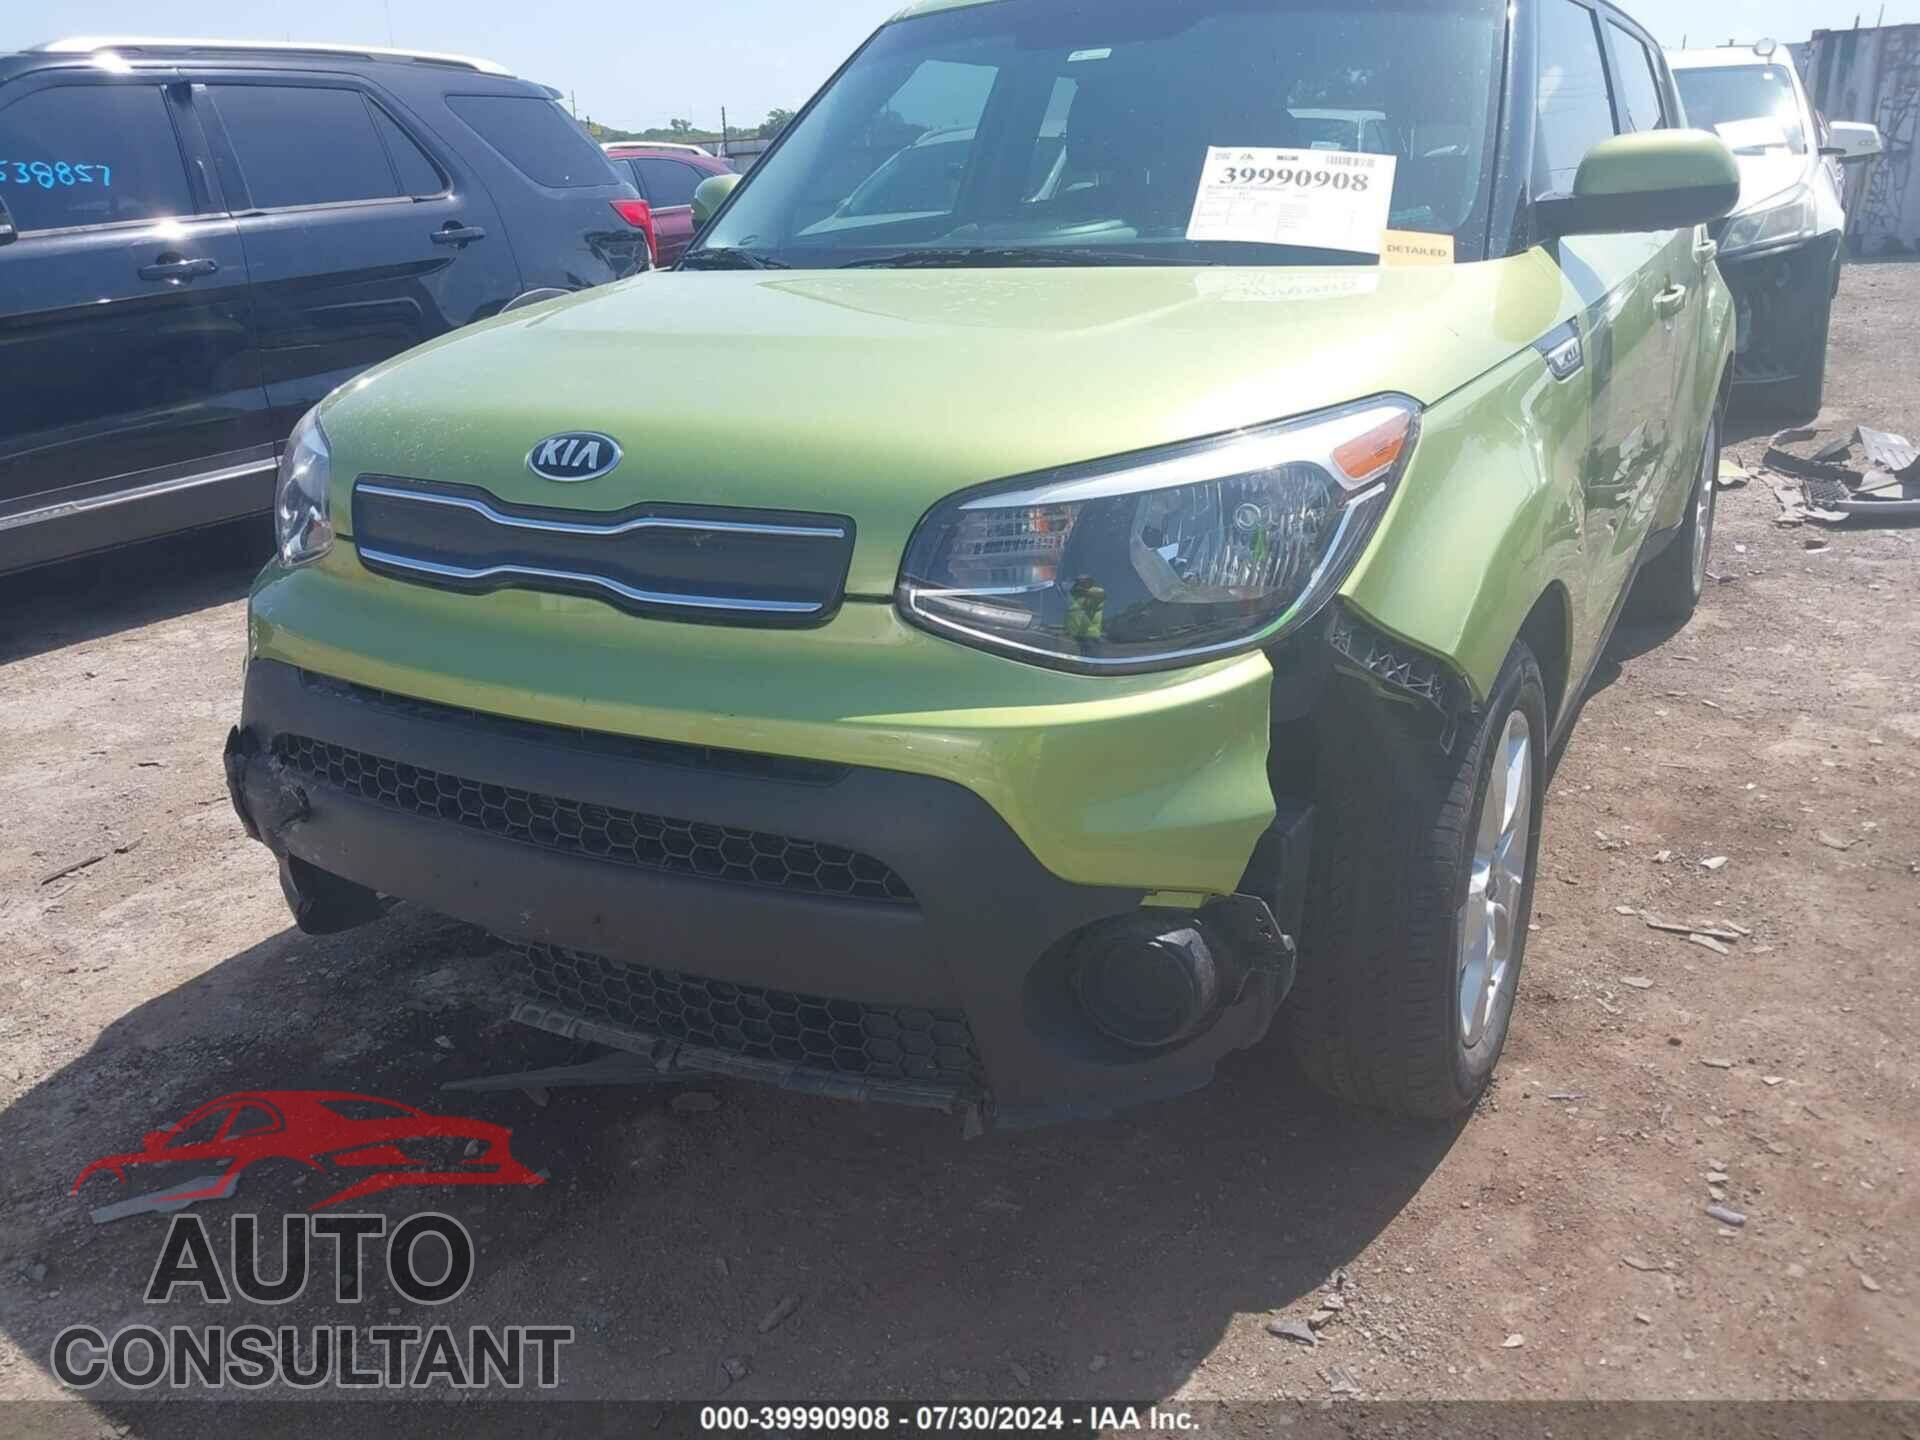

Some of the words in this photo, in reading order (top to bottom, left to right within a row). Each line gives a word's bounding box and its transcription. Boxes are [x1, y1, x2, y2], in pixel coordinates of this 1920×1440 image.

[1219, 166, 1369, 192] 39990908
[1386, 243, 1448, 257] DETAILED
[537, 438, 601, 470] KIA
